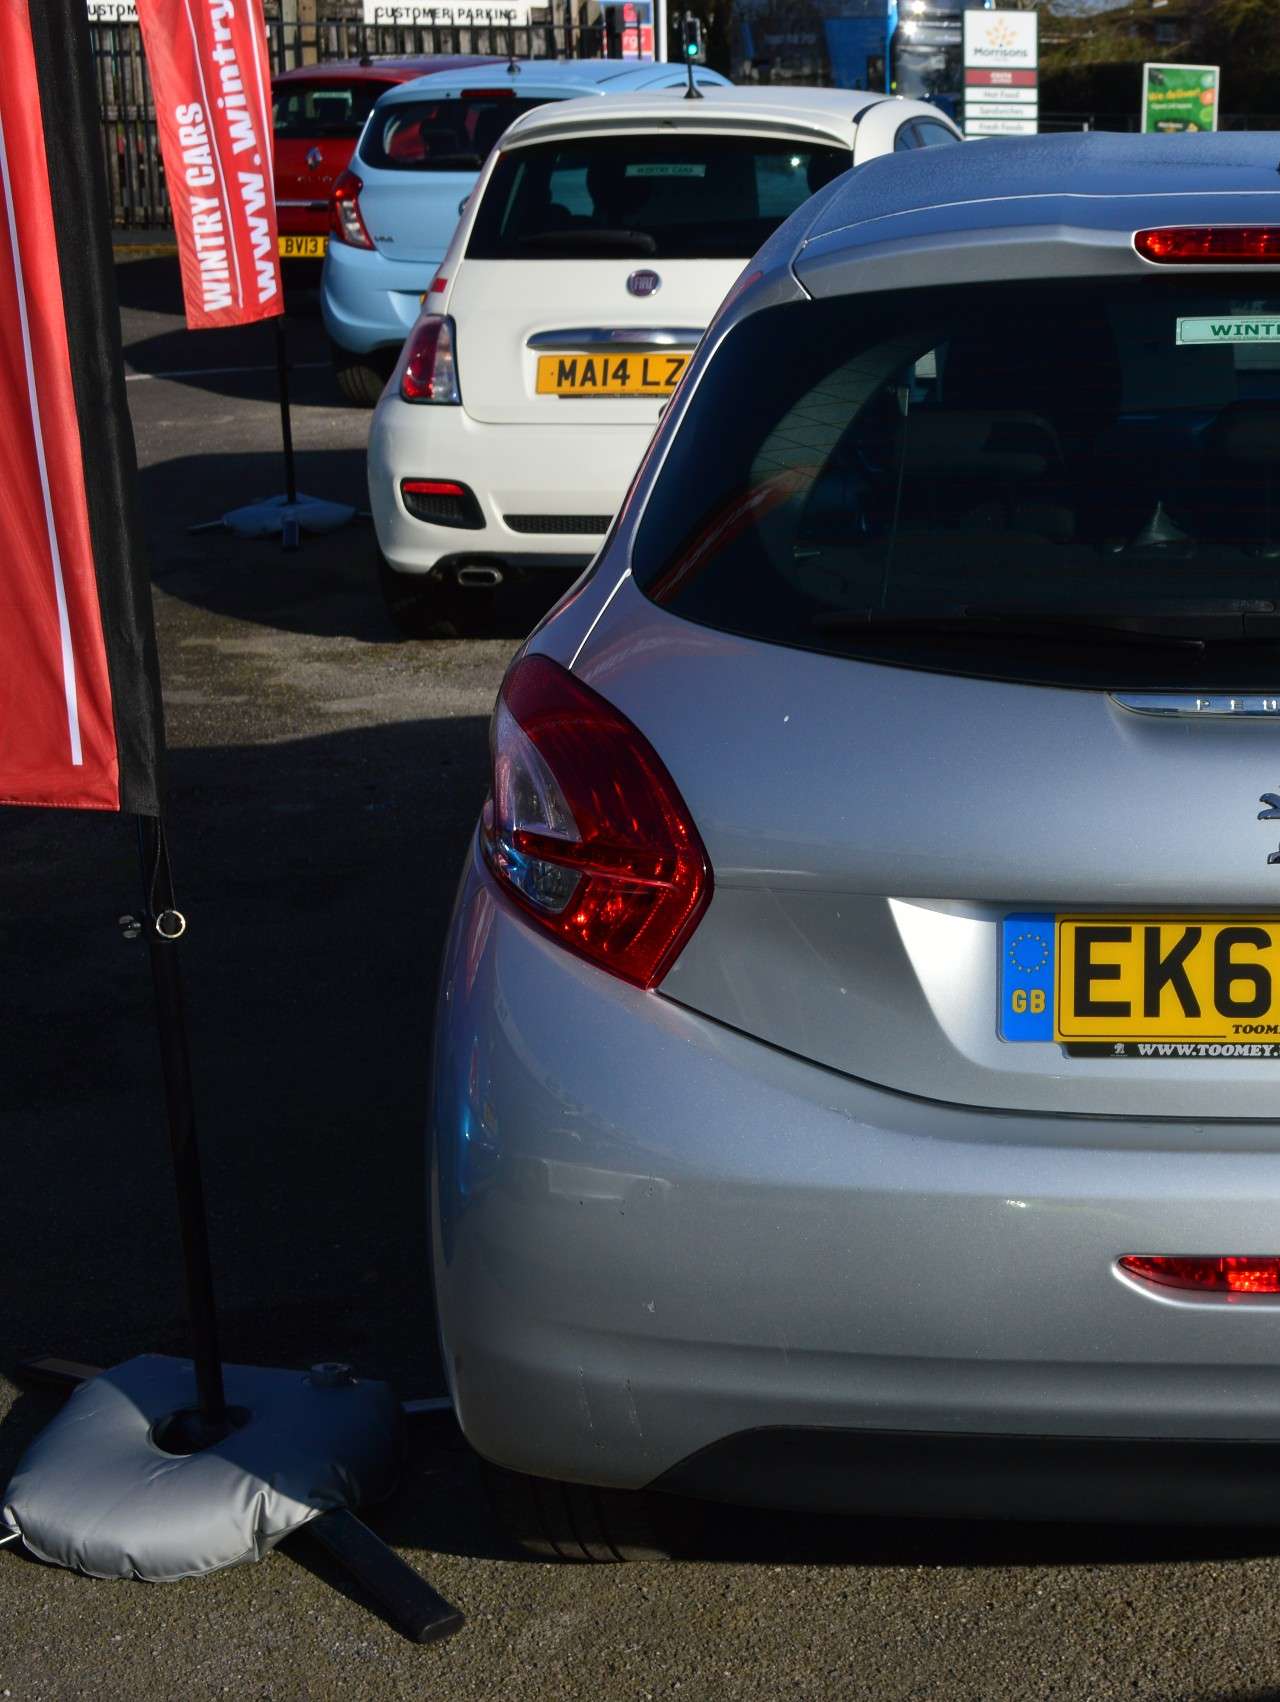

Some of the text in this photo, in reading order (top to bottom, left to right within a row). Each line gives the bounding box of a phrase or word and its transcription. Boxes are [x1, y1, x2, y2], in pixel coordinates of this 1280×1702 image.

[375, 7, 517, 19] CUSTOMER PARKING
[974, 48, 1028, 57] Morrisons
[176, 102, 232, 312] WINTRY CARS
[285, 238, 318, 253] BV13
[556, 358, 630, 387] MA14
[1012, 988, 1046, 1014] GB
